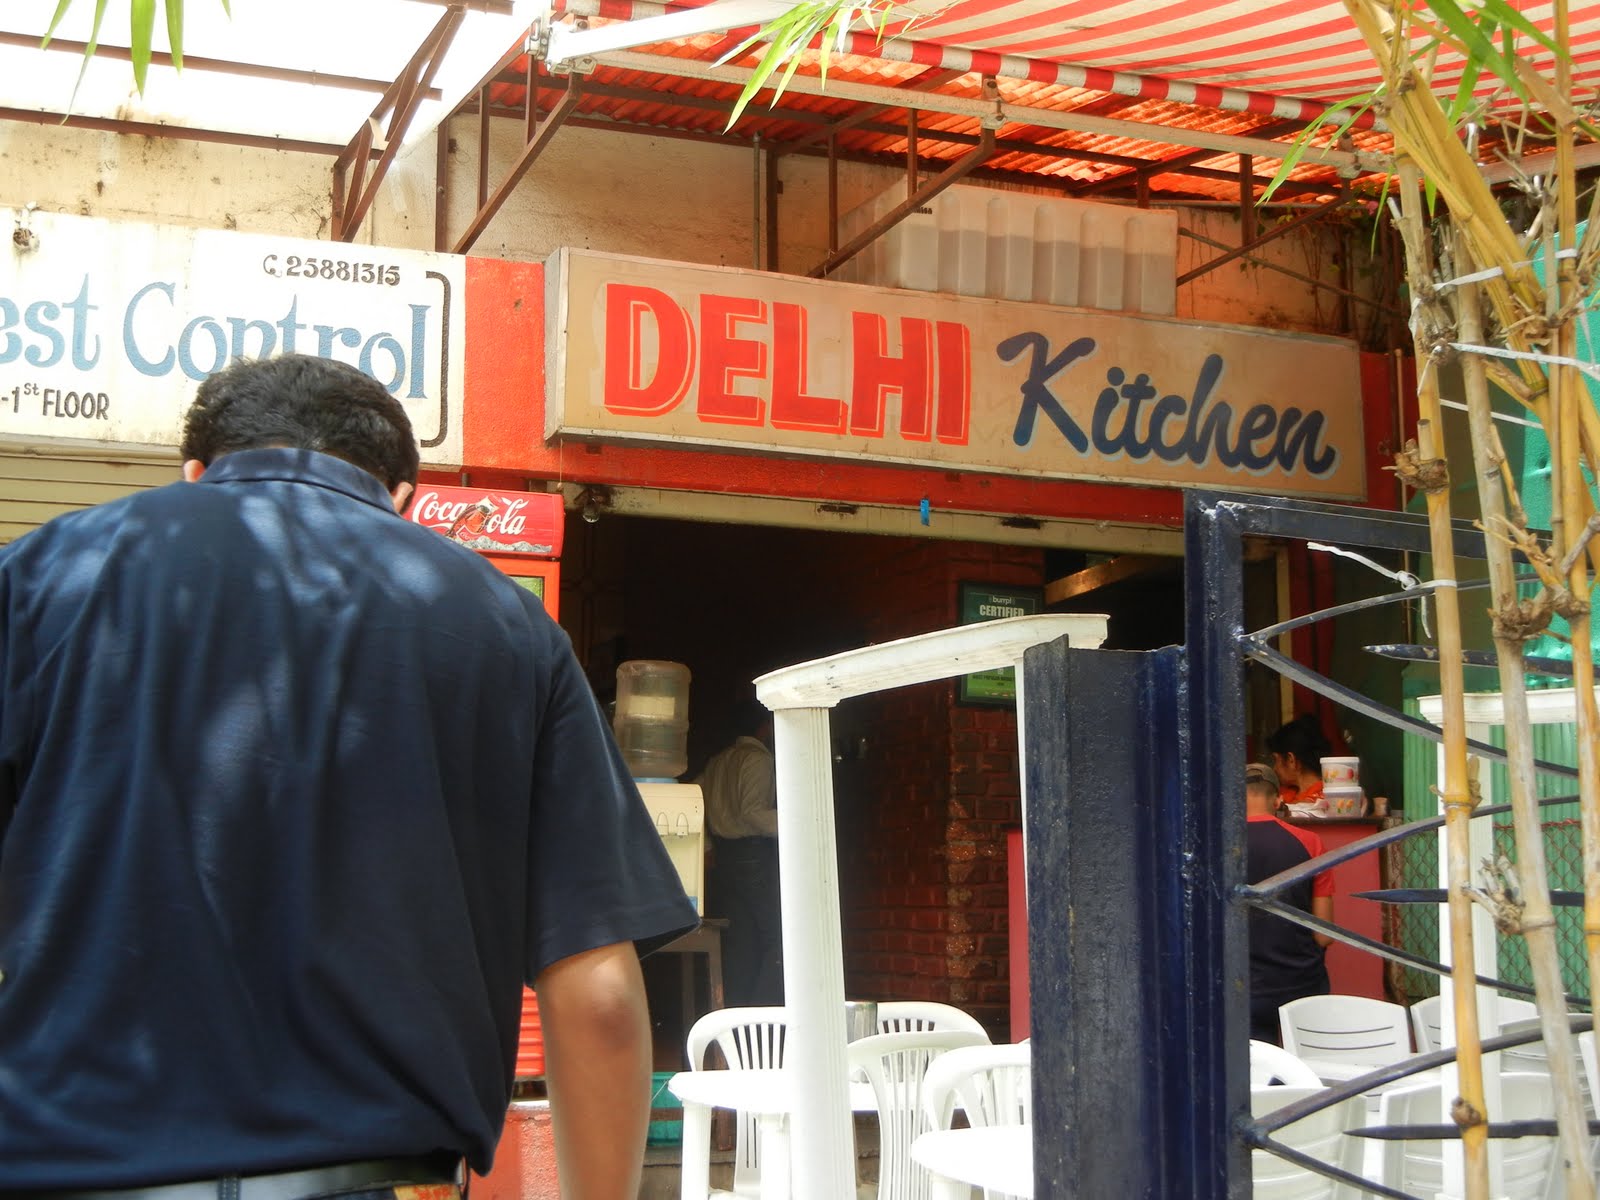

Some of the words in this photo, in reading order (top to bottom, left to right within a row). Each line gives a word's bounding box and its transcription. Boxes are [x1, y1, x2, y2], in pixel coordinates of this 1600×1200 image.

[286, 255, 400, 286] 25881315
[123, 281, 431, 399] Control
[604, 283, 971, 446] DELHI
[996, 331, 1341, 479] Kitchen
[42, 388, 110, 420] FLOOR
[979, 604, 1025, 618] CERTIFIED
